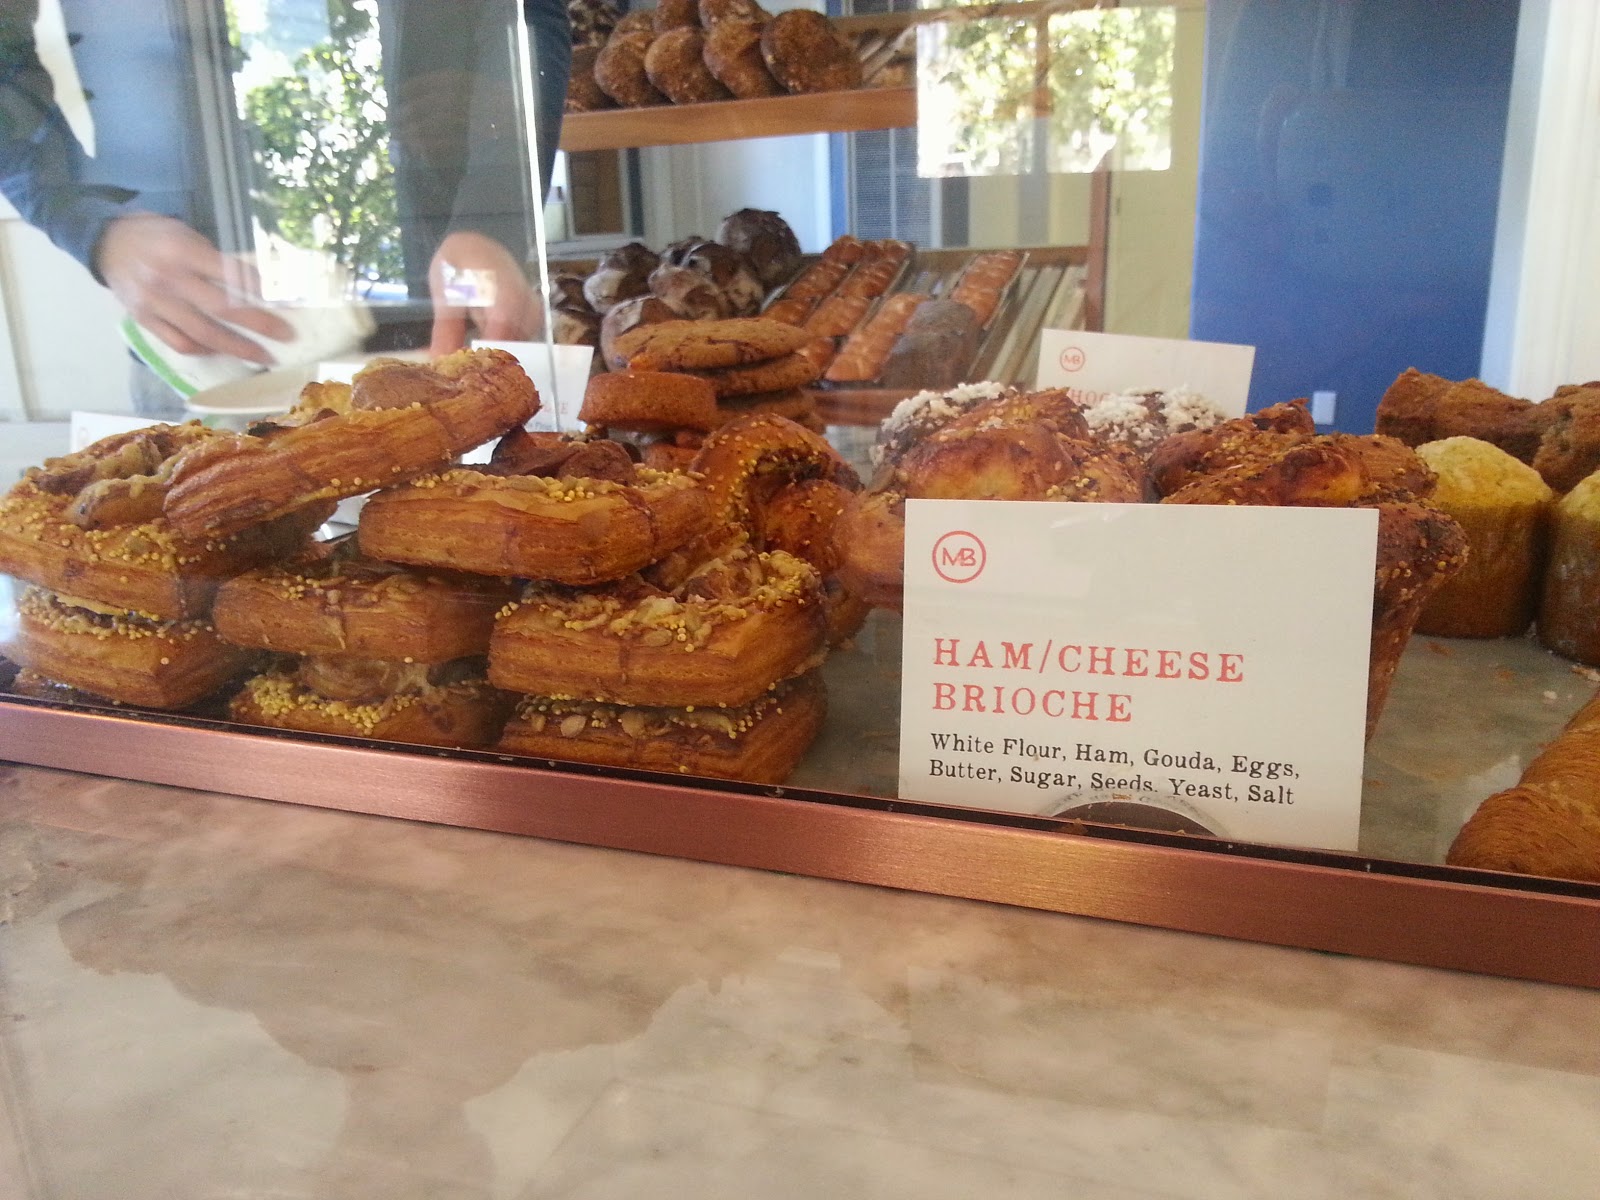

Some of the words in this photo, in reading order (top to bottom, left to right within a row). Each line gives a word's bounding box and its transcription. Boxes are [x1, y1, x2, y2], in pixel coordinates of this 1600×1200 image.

[933, 637, 1245, 683] HAM/CHEESE
[932, 682, 1133, 723] BRIOCHE
[931, 733, 994, 753] White
[1002, 738, 1067, 762] Flour,
[1075, 743, 1134, 767] Ham,
[1143, 749, 1222, 773] Gouda,
[1231, 755, 1300, 780] Eggs,
[929, 759, 1002, 783] Butter,
[1010, 766, 1082, 790] Sugar,
[1168, 778, 1238, 802] Yeast,
[1247, 784, 1295, 805] Salt
